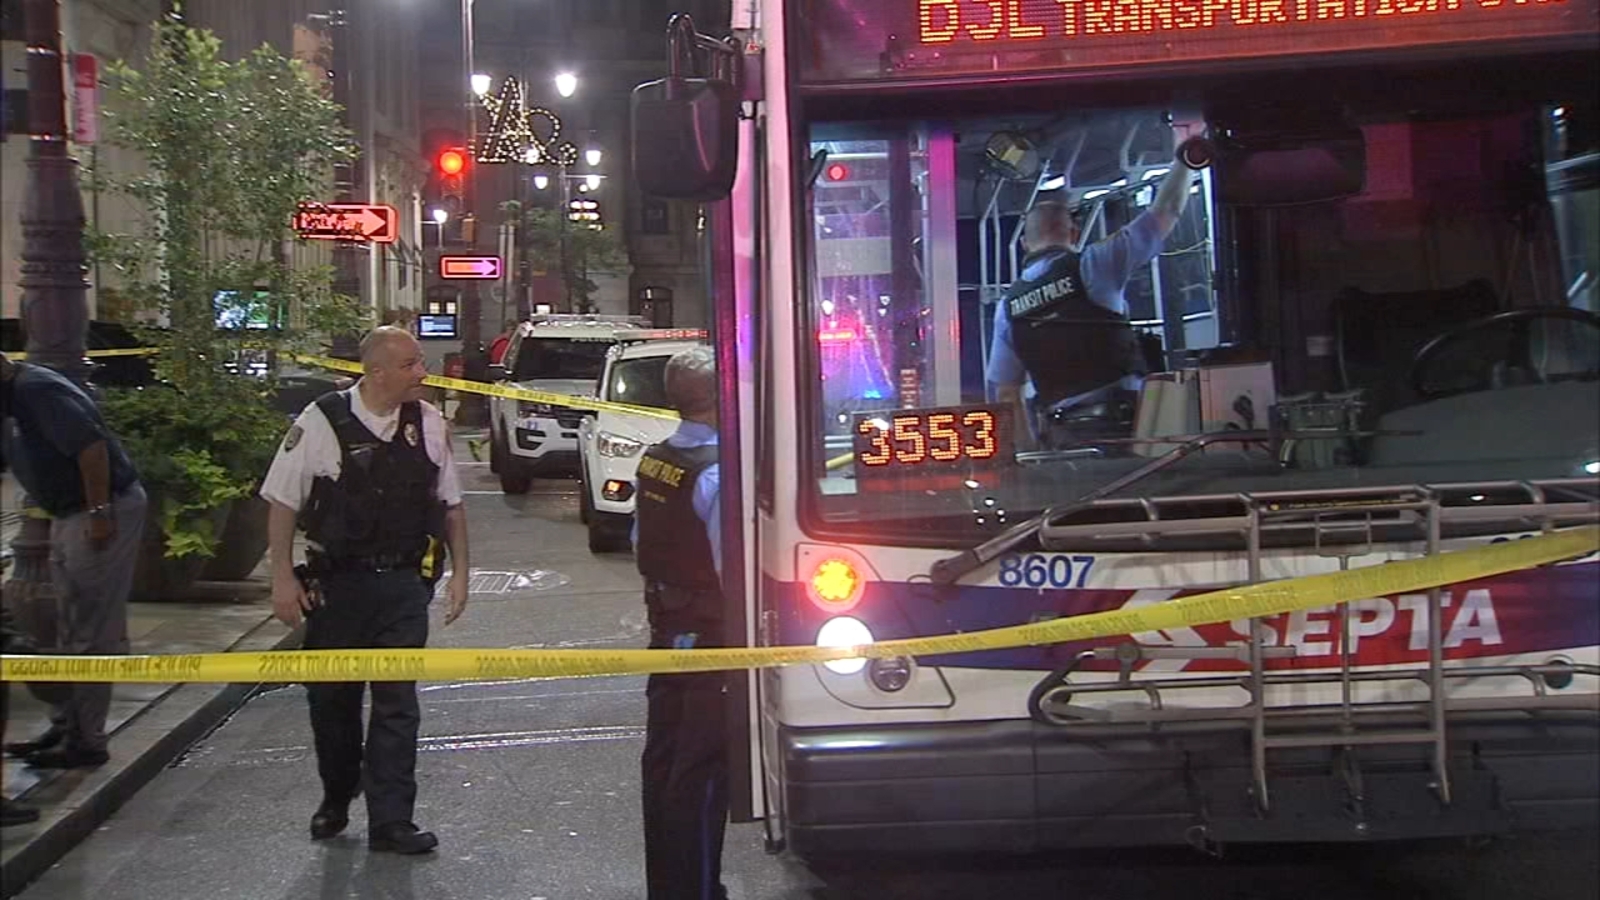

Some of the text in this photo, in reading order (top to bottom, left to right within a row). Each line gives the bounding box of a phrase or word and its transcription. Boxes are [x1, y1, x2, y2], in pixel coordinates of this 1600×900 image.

[1009, 276, 1075, 317] TRANSIT POLICE
[859, 411, 995, 465] 3553
[999, 553, 1095, 588] 8607
[1225, 589, 1503, 662] SEPTA
